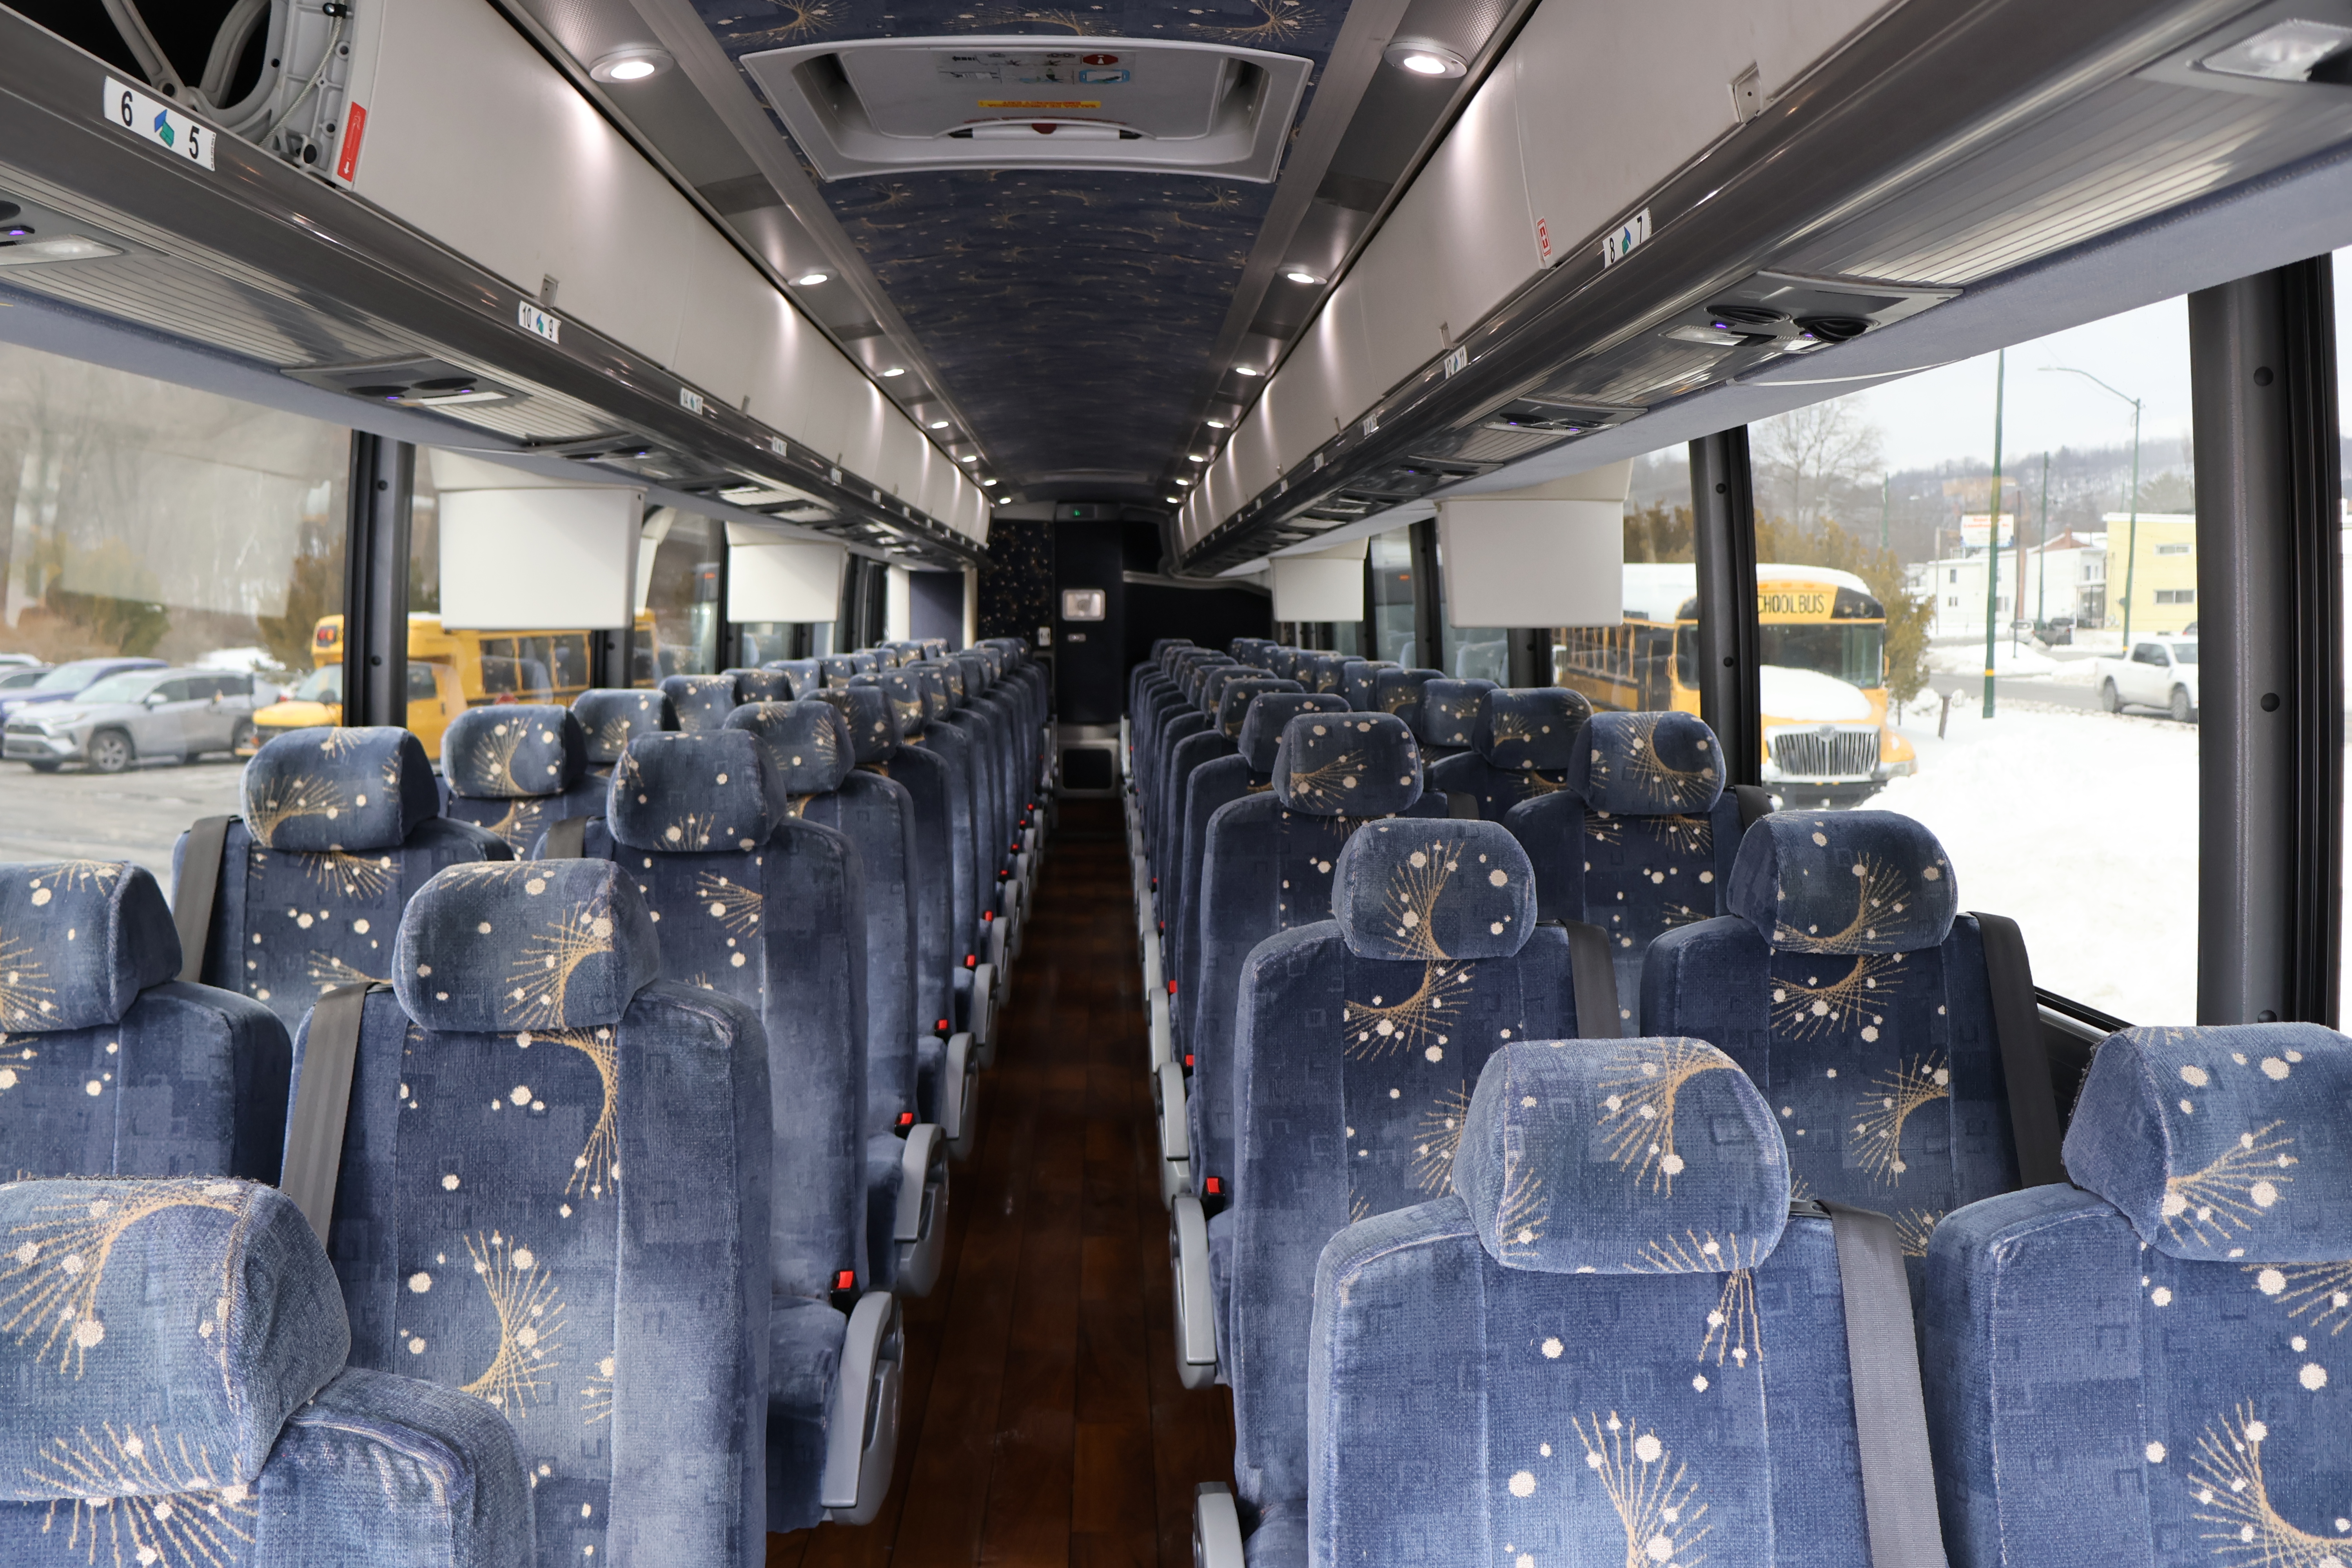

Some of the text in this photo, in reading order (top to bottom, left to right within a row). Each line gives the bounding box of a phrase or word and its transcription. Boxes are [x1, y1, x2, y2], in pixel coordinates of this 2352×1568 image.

[122, 91, 133, 127] 6
[189, 125, 200, 160] 5
[1610, 237, 1615, 263] 8
[1637, 215, 1642, 244] 7
[523, 305, 553, 338] 10 9
[1758, 594, 1824, 614] CHOOL BUS
